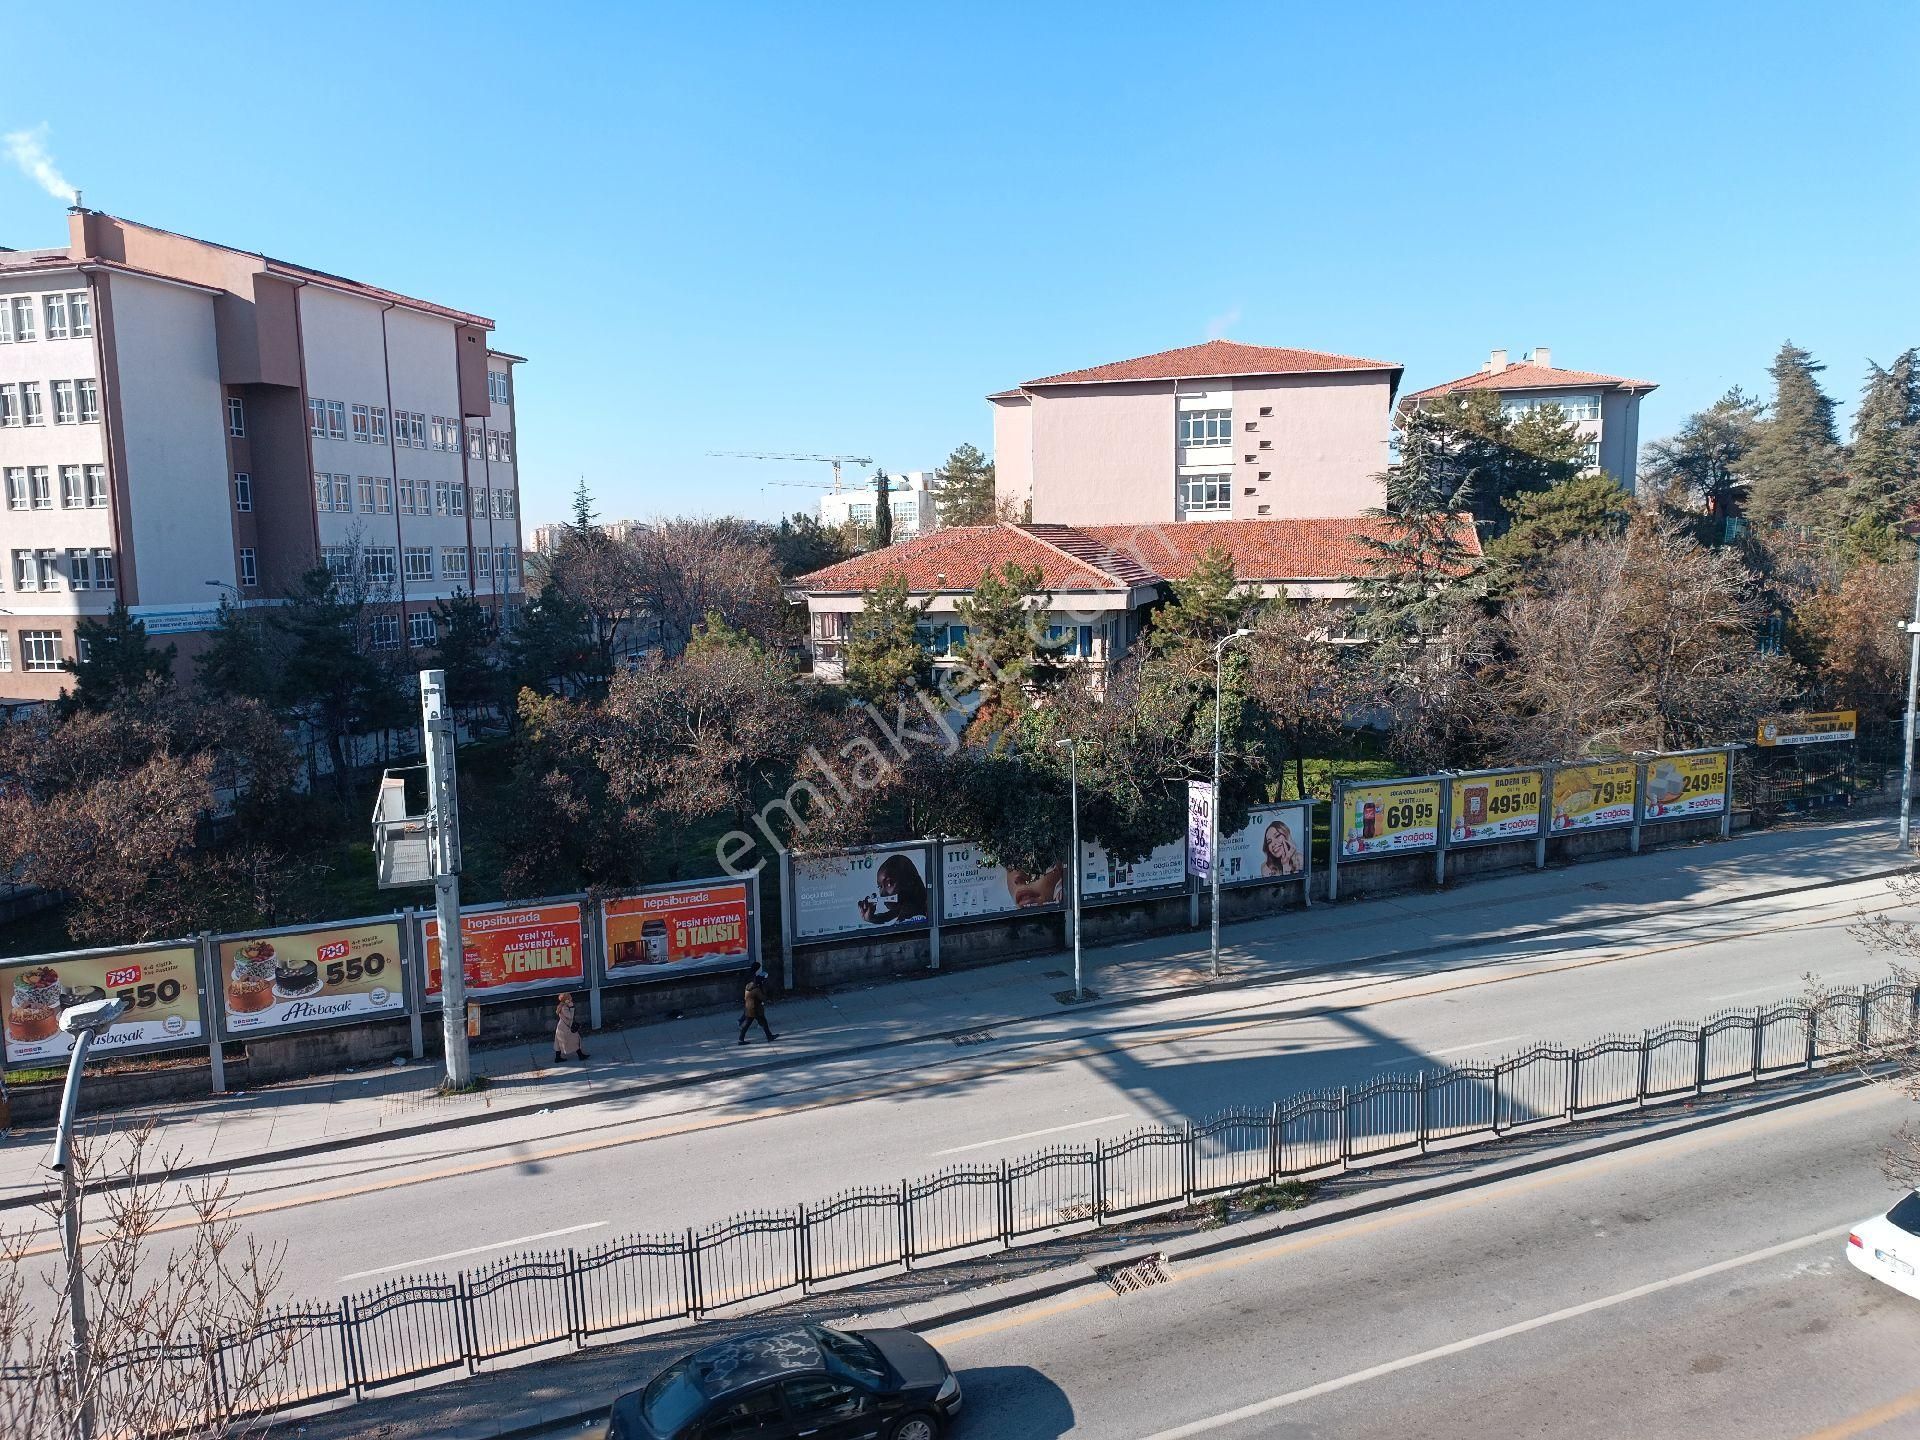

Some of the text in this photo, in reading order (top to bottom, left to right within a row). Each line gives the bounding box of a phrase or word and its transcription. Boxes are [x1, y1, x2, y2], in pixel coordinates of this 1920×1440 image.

[1495, 776, 1531, 787] BADEM İÇİ
[1488, 791, 1537, 814] 495,00
[1249, 815, 1263, 825] TO
[1387, 803, 1433, 829] 69,95
[1507, 818, 1537, 830] çağdaş
[1402, 832, 1434, 844] çağdaş
[643, 892, 709, 909] hepsiburada
[467, 911, 541, 930] hepsiburada
[676, 914, 741, 929] PEŞİN FİYATINA
[517, 930, 556, 941] YENİ YIL
[675, 928, 687, 948] 9
[688, 922, 742, 946] TAKSİT
[503, 937, 570, 952] ALIŞVERİŞİYLE
[502, 946, 573, 973] YENİLEN
